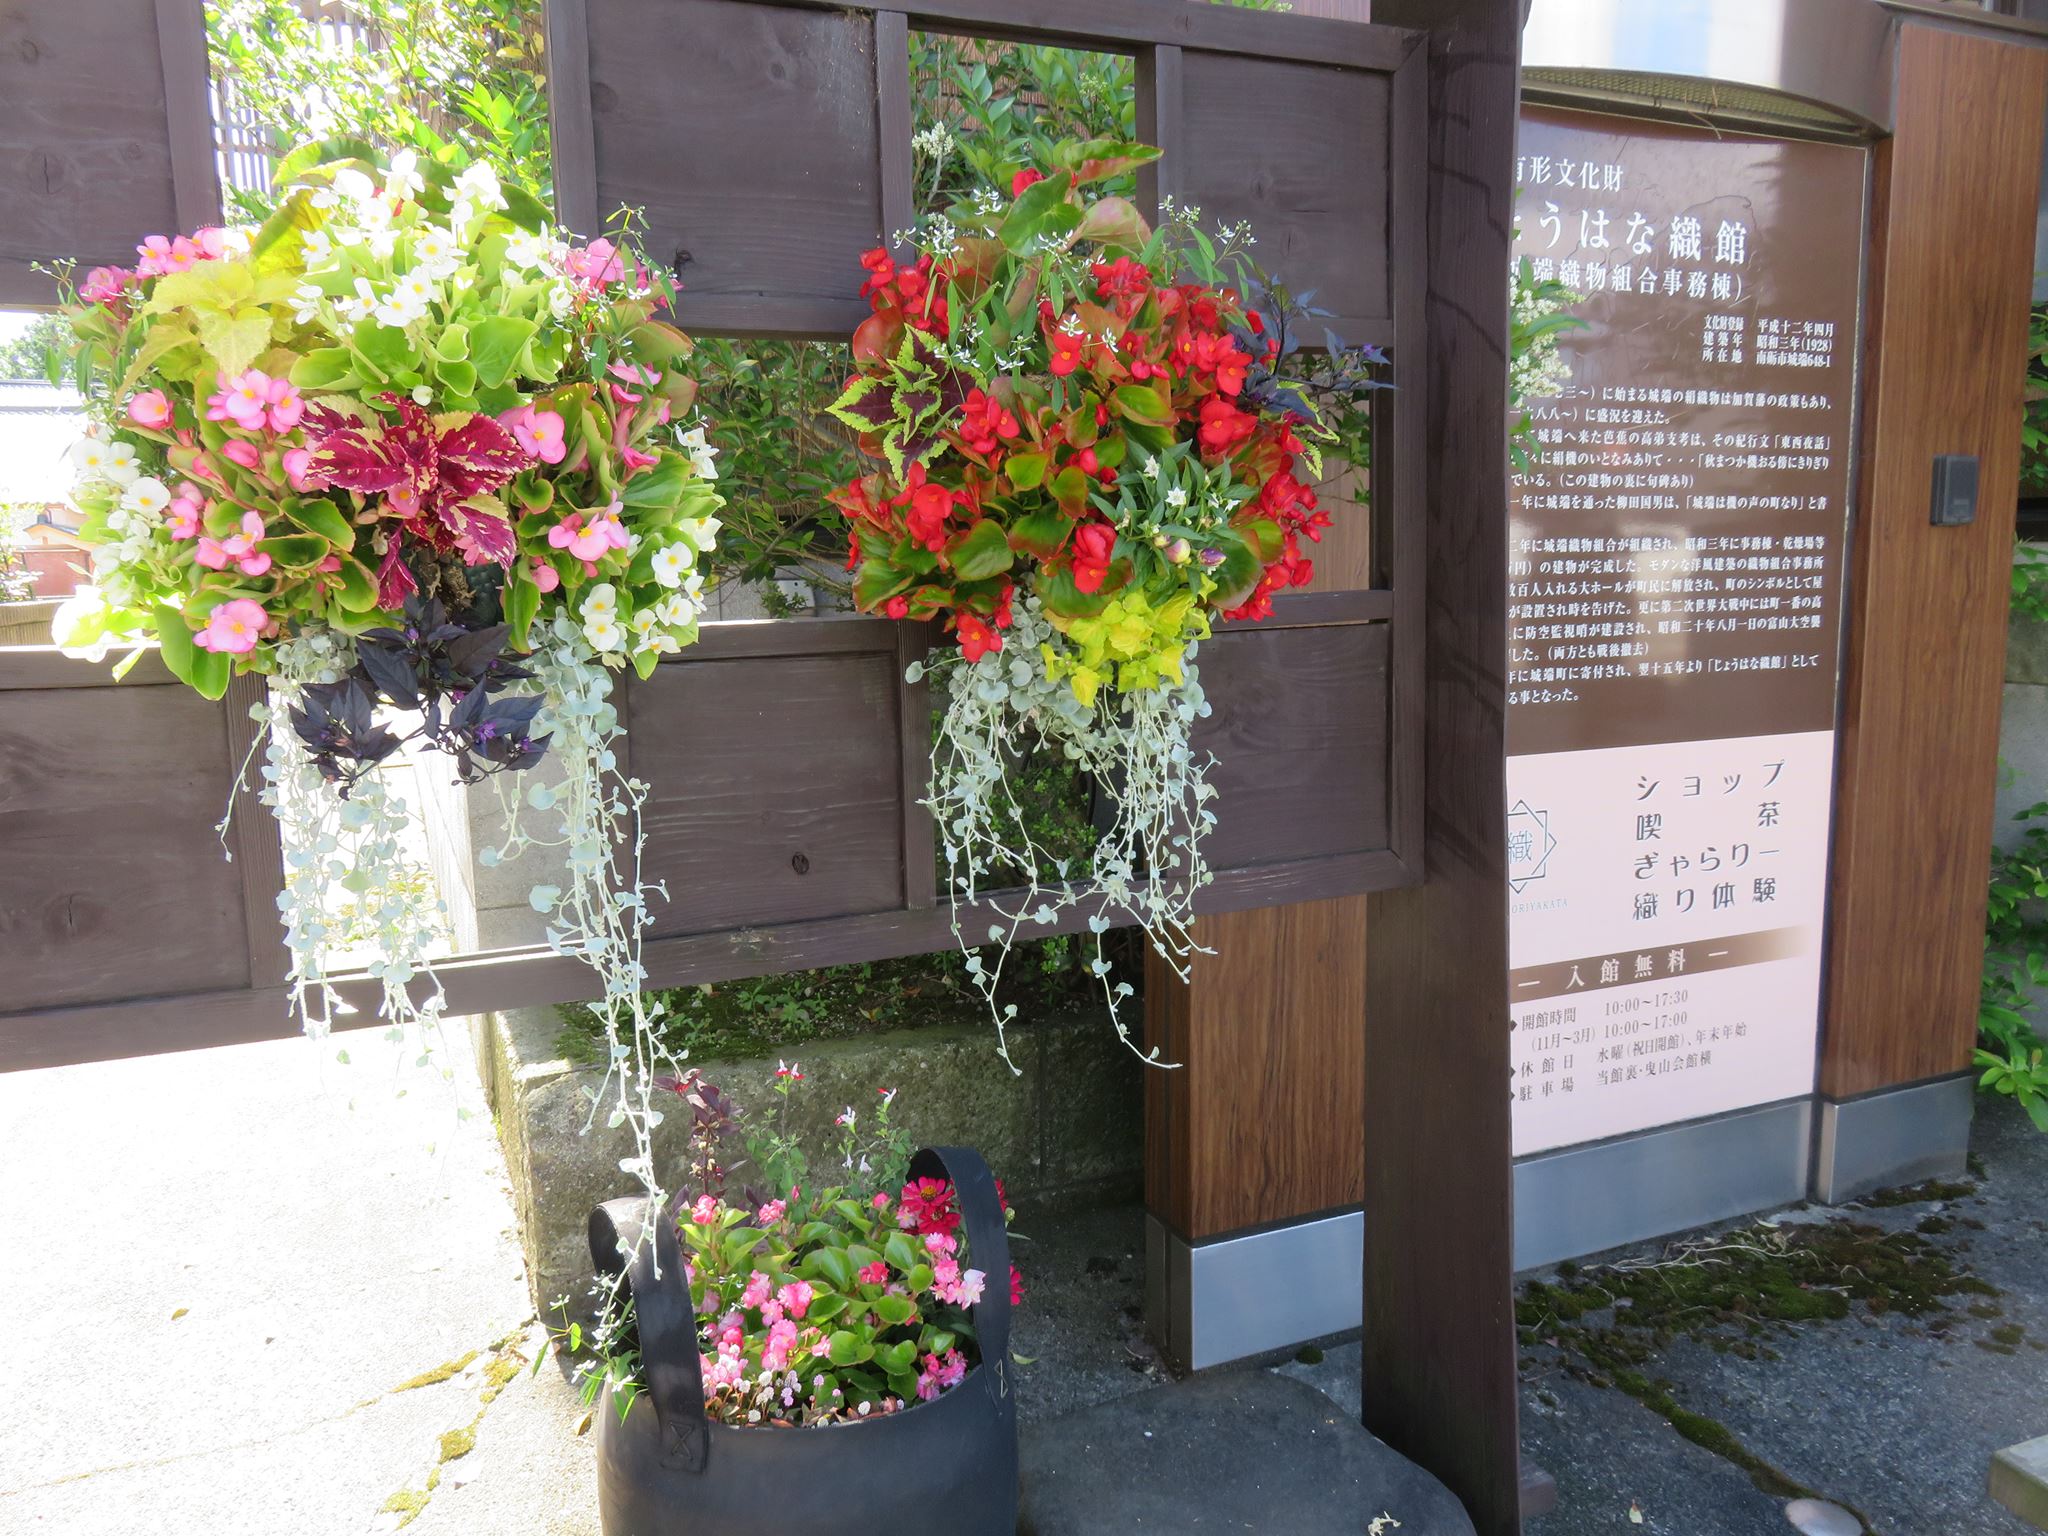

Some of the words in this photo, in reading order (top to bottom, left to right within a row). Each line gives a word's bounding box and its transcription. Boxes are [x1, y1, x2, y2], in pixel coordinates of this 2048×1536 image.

[1703, 314, 1745, 331] 文化財登録
[1757, 319, 1834, 337] 平成十二年四月
[1702, 332, 1743, 348] 建築年
[1756, 335, 1833, 353] 昭和三年(1928)
[1701, 347, 1743, 364] 所在地
[1508, 615, 1821, 640] に防空監視哨が建設され、昭和二十年八月一日の富山大空襲
[1636, 758, 1785, 801] ショップ
[1632, 843, 1781, 880] ぎゃらりー
[1632, 877, 1778, 921] 織り体験
[1565, 948, 1687, 991] 入館無料
[1521, 1007, 1578, 1032] 開館時間
[1520, 1054, 1575, 1077] 休館日
[1519, 1077, 1574, 1102] 駐車場
